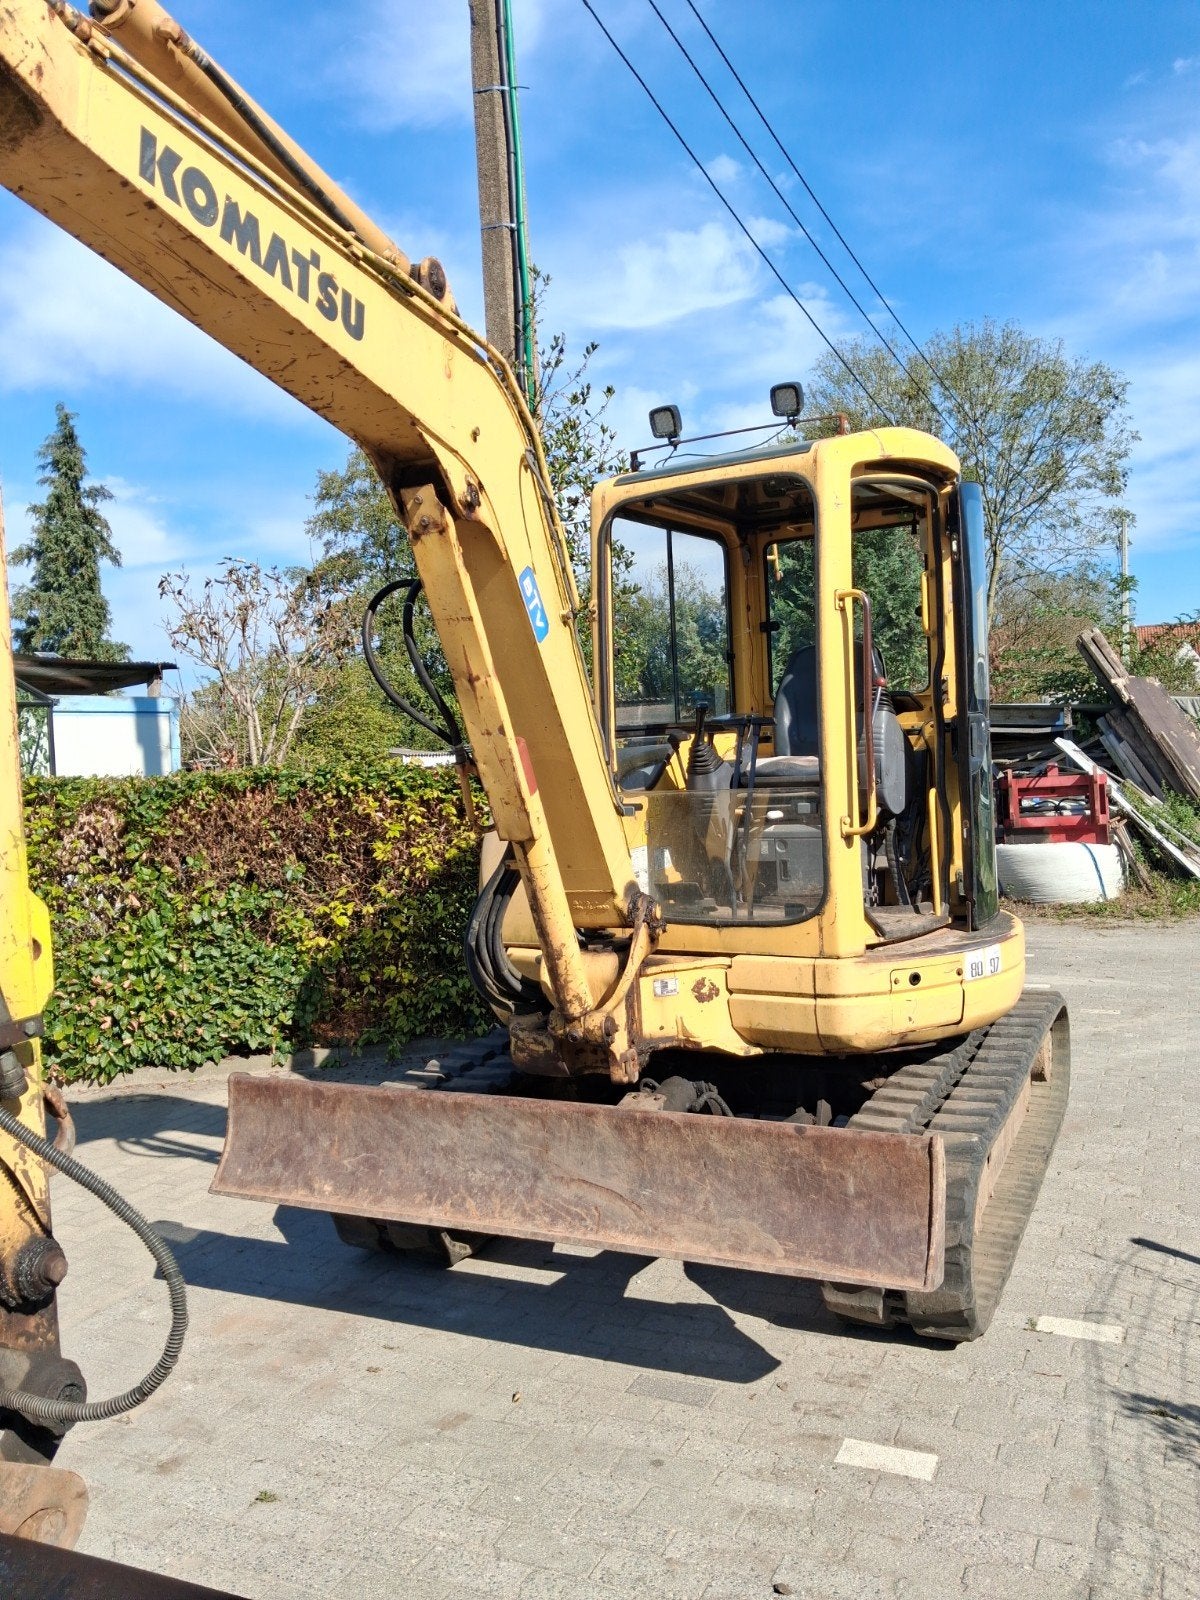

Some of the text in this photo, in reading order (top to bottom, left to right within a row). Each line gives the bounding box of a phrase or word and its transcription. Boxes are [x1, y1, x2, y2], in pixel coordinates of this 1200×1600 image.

[139, 125, 365, 341] KOMATSU
[970, 956, 1000, 978] 80 97
